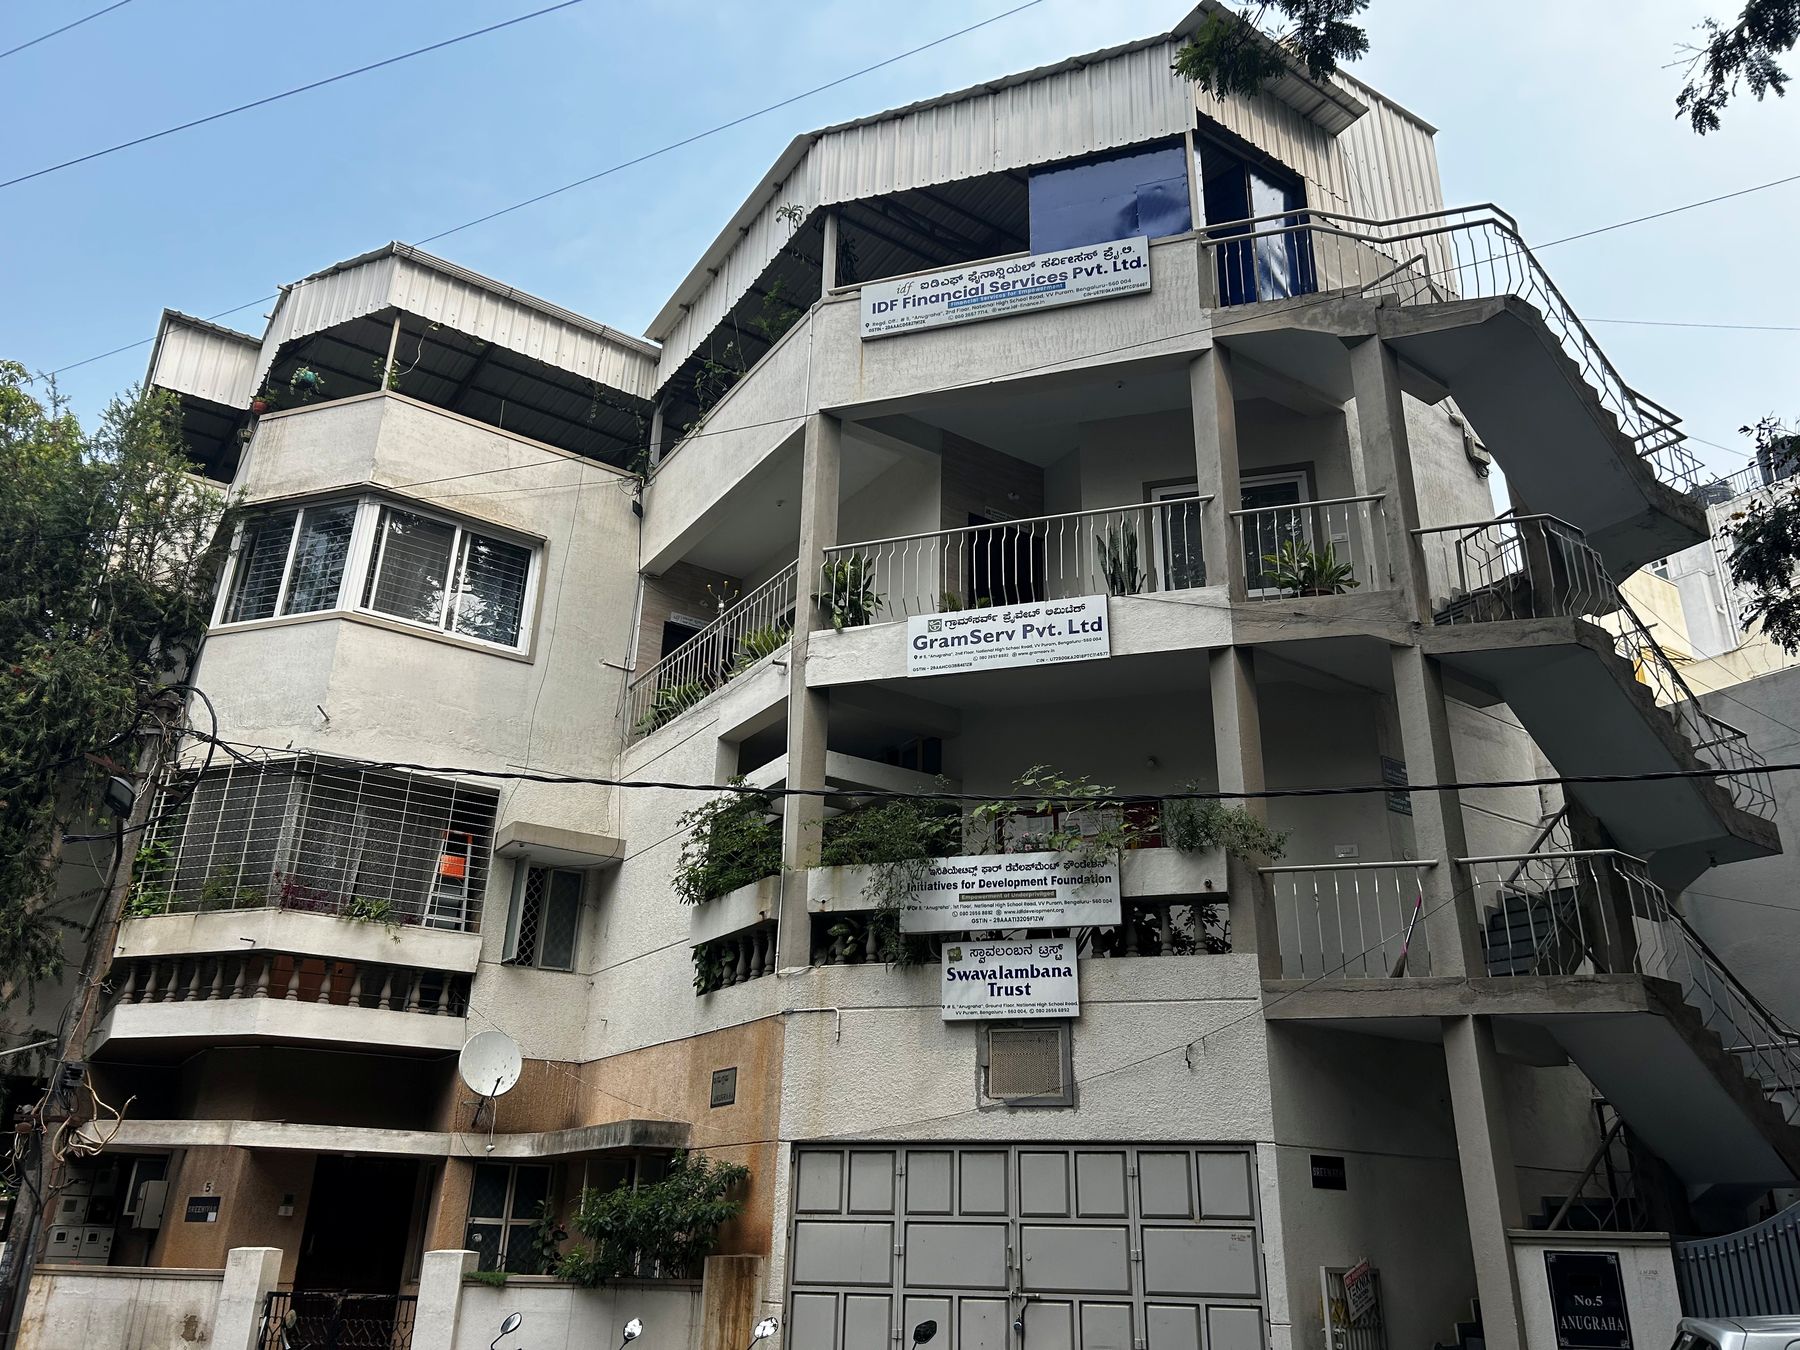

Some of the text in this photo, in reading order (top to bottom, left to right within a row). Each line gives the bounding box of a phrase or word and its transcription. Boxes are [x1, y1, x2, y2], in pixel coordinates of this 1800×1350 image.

[872, 255, 1148, 315] IDF Financial Services Pvt. Ltd.
[896, 281, 914, 297] idf
[950, 283, 1063, 308] Financial Services for Empowerment
[971, 302, 995, 311] National
[996, 299, 1008, 308] High
[1009, 296, 1028, 305] School
[1046, 291, 1054, 299] VV
[912, 616, 1103, 651] GramServ Pvt. Ltd
[907, 874, 1112, 892] Initiatives for Development Foundation
[961, 893, 1003, 902] Empowerment
[946, 964, 1073, 982] Swavalambana
[987, 982, 1032, 997] Trust
[980, 1009, 1004, 1017] Bengaluru
[204, 1182, 212, 1193] 5
[1573, 1294, 1604, 1307] No.5
[1560, 1315, 1625, 1332] ANUGRAHA
